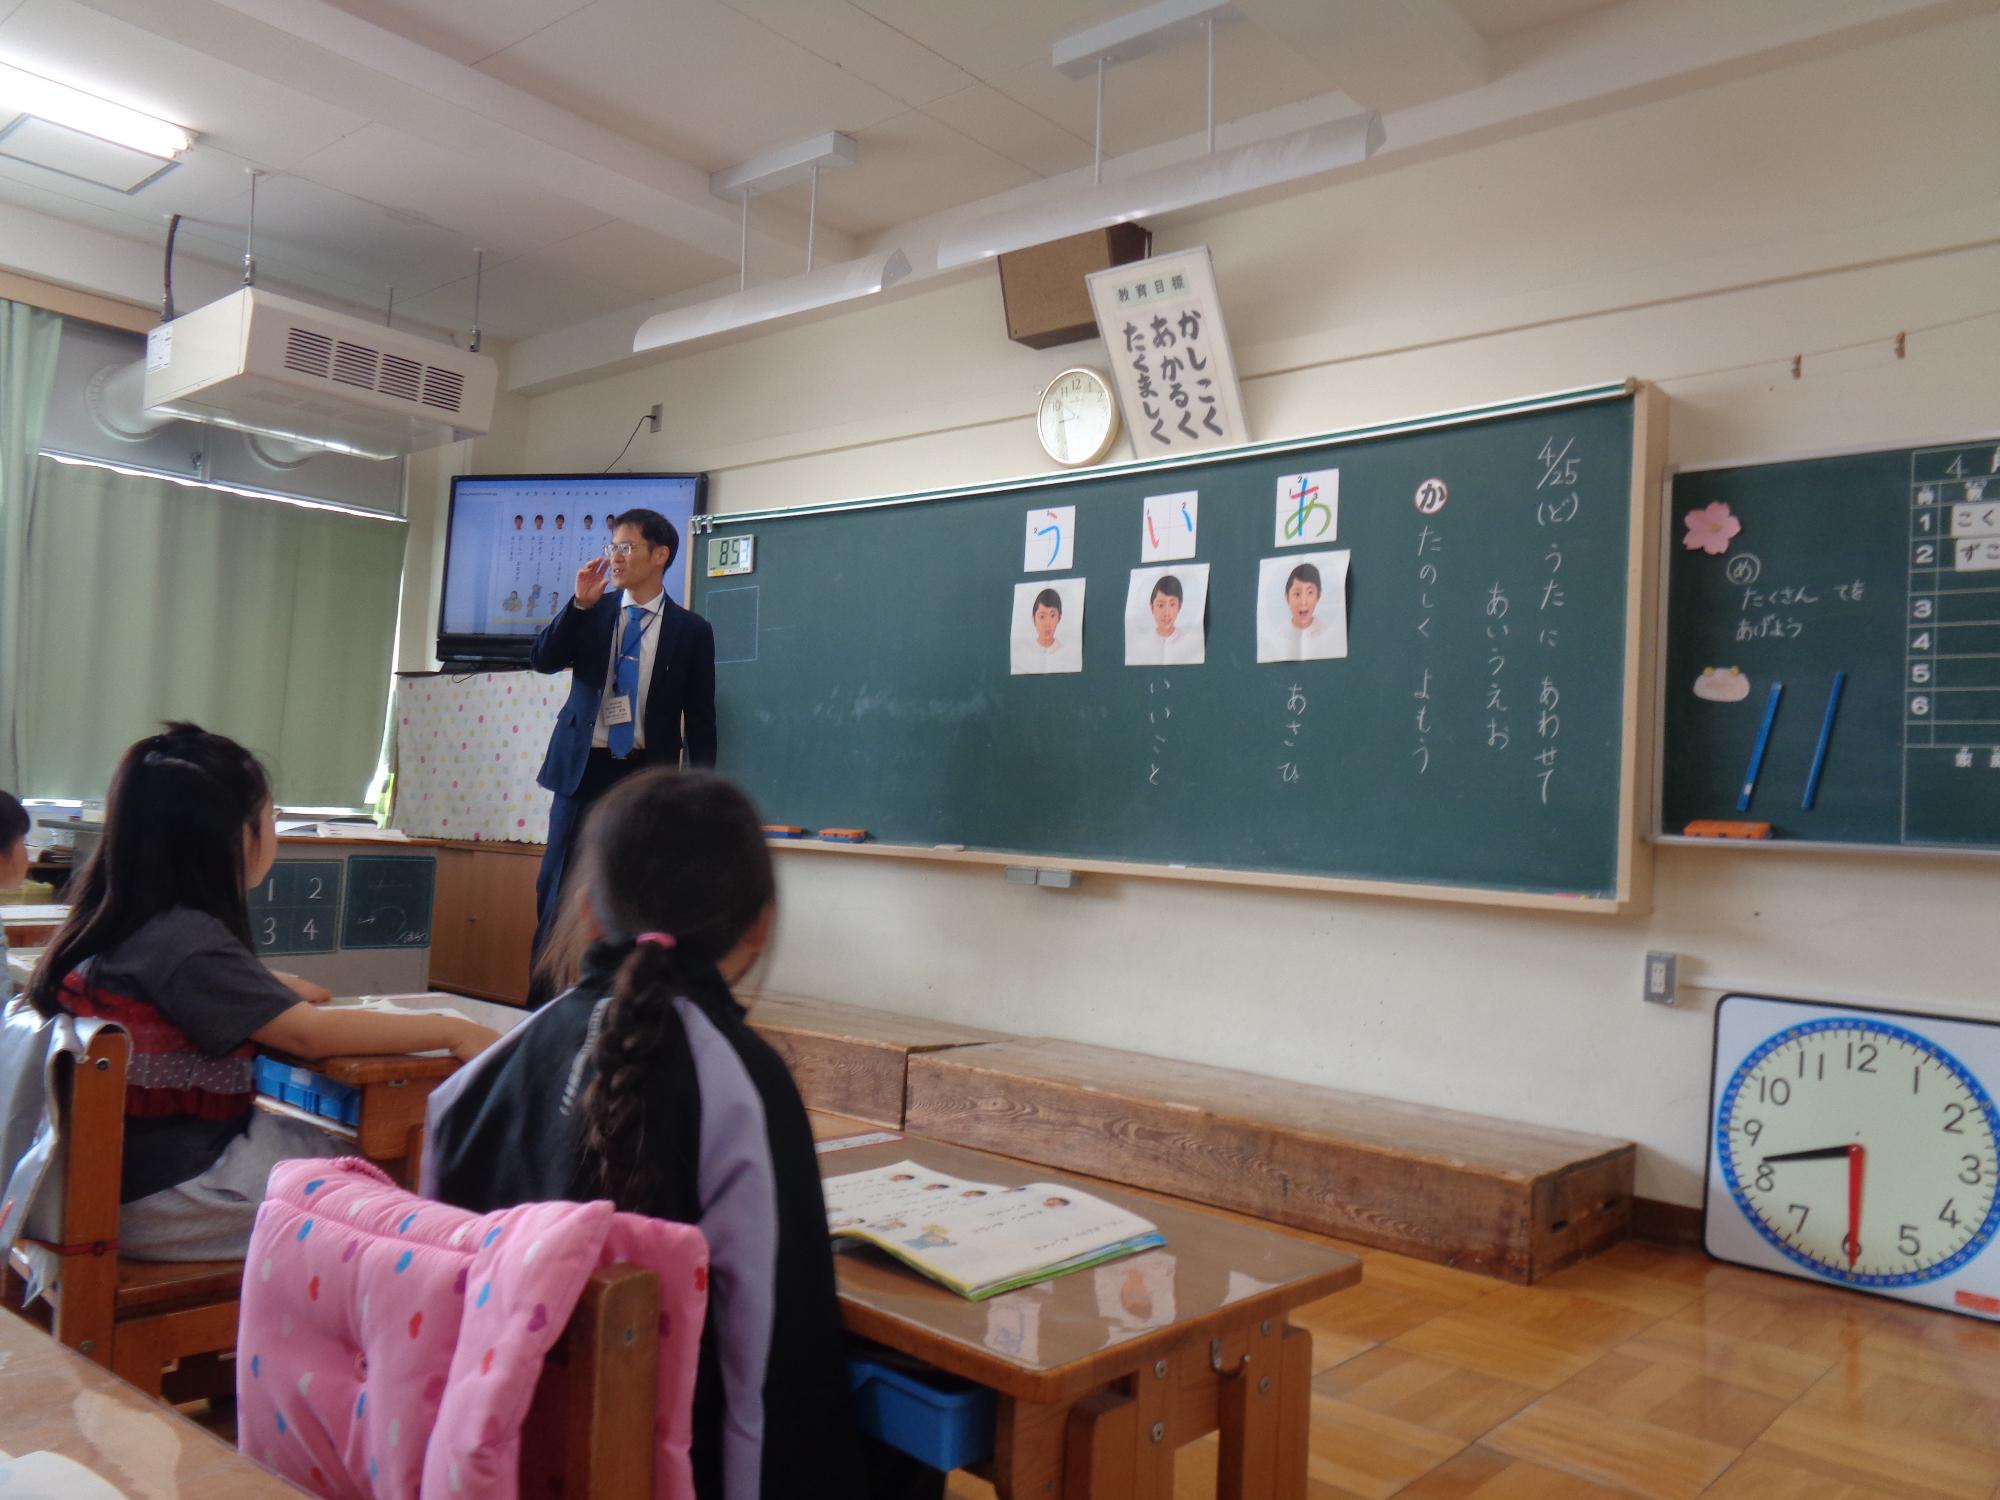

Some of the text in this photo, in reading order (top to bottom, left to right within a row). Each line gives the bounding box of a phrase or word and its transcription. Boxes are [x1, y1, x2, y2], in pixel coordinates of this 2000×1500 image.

[1117, 273, 1185, 303] 教育目標
[1123, 321, 1171, 445] たくましく
[1150, 313, 1199, 440] あかるく
[1177, 309, 1223, 437] かしこく
[1283, 477, 1332, 541] あ
[1419, 481, 1447, 511] か
[1146, 509, 1193, 549] い
[1919, 513, 1931, 532] 1
[1037, 511, 1062, 567] う
[1916, 543, 1934, 564] 2
[1742, 586, 1819, 611] たくさん
[1912, 598, 1932, 619] 3
[1736, 612, 1803, 642] あげよう
[1911, 631, 1931, 651] 4
[1413, 525, 1442, 774] たのしく よもう
[1486, 582, 1509, 750] あいうえお
[1911, 663, 1931, 684] 5
[1911, 695, 1930, 716] 6
[1149, 679, 1170, 786] いいこと
[1278, 683, 1306, 785] あさひ
[1533, 676, 1560, 804] あわせて
[267, 876, 323, 902] 1 2
[261, 916, 319, 945] 3 4
[1798, 1050, 1825, 1082] 11
[1846, 1042, 1879, 1073] 12
[1758, 1075, 1791, 1106] 10
[1912, 1065, 1920, 1095] 1
[1743, 1118, 1763, 1147] 9
[1942, 1103, 1966, 1135] 2
[1754, 1163, 1775, 1193] 8
[1957, 1154, 1982, 1186] 3
[1787, 1203, 1810, 1234] 7
[1938, 1198, 1962, 1229] 4
[1897, 1224, 1920, 1257] 5
